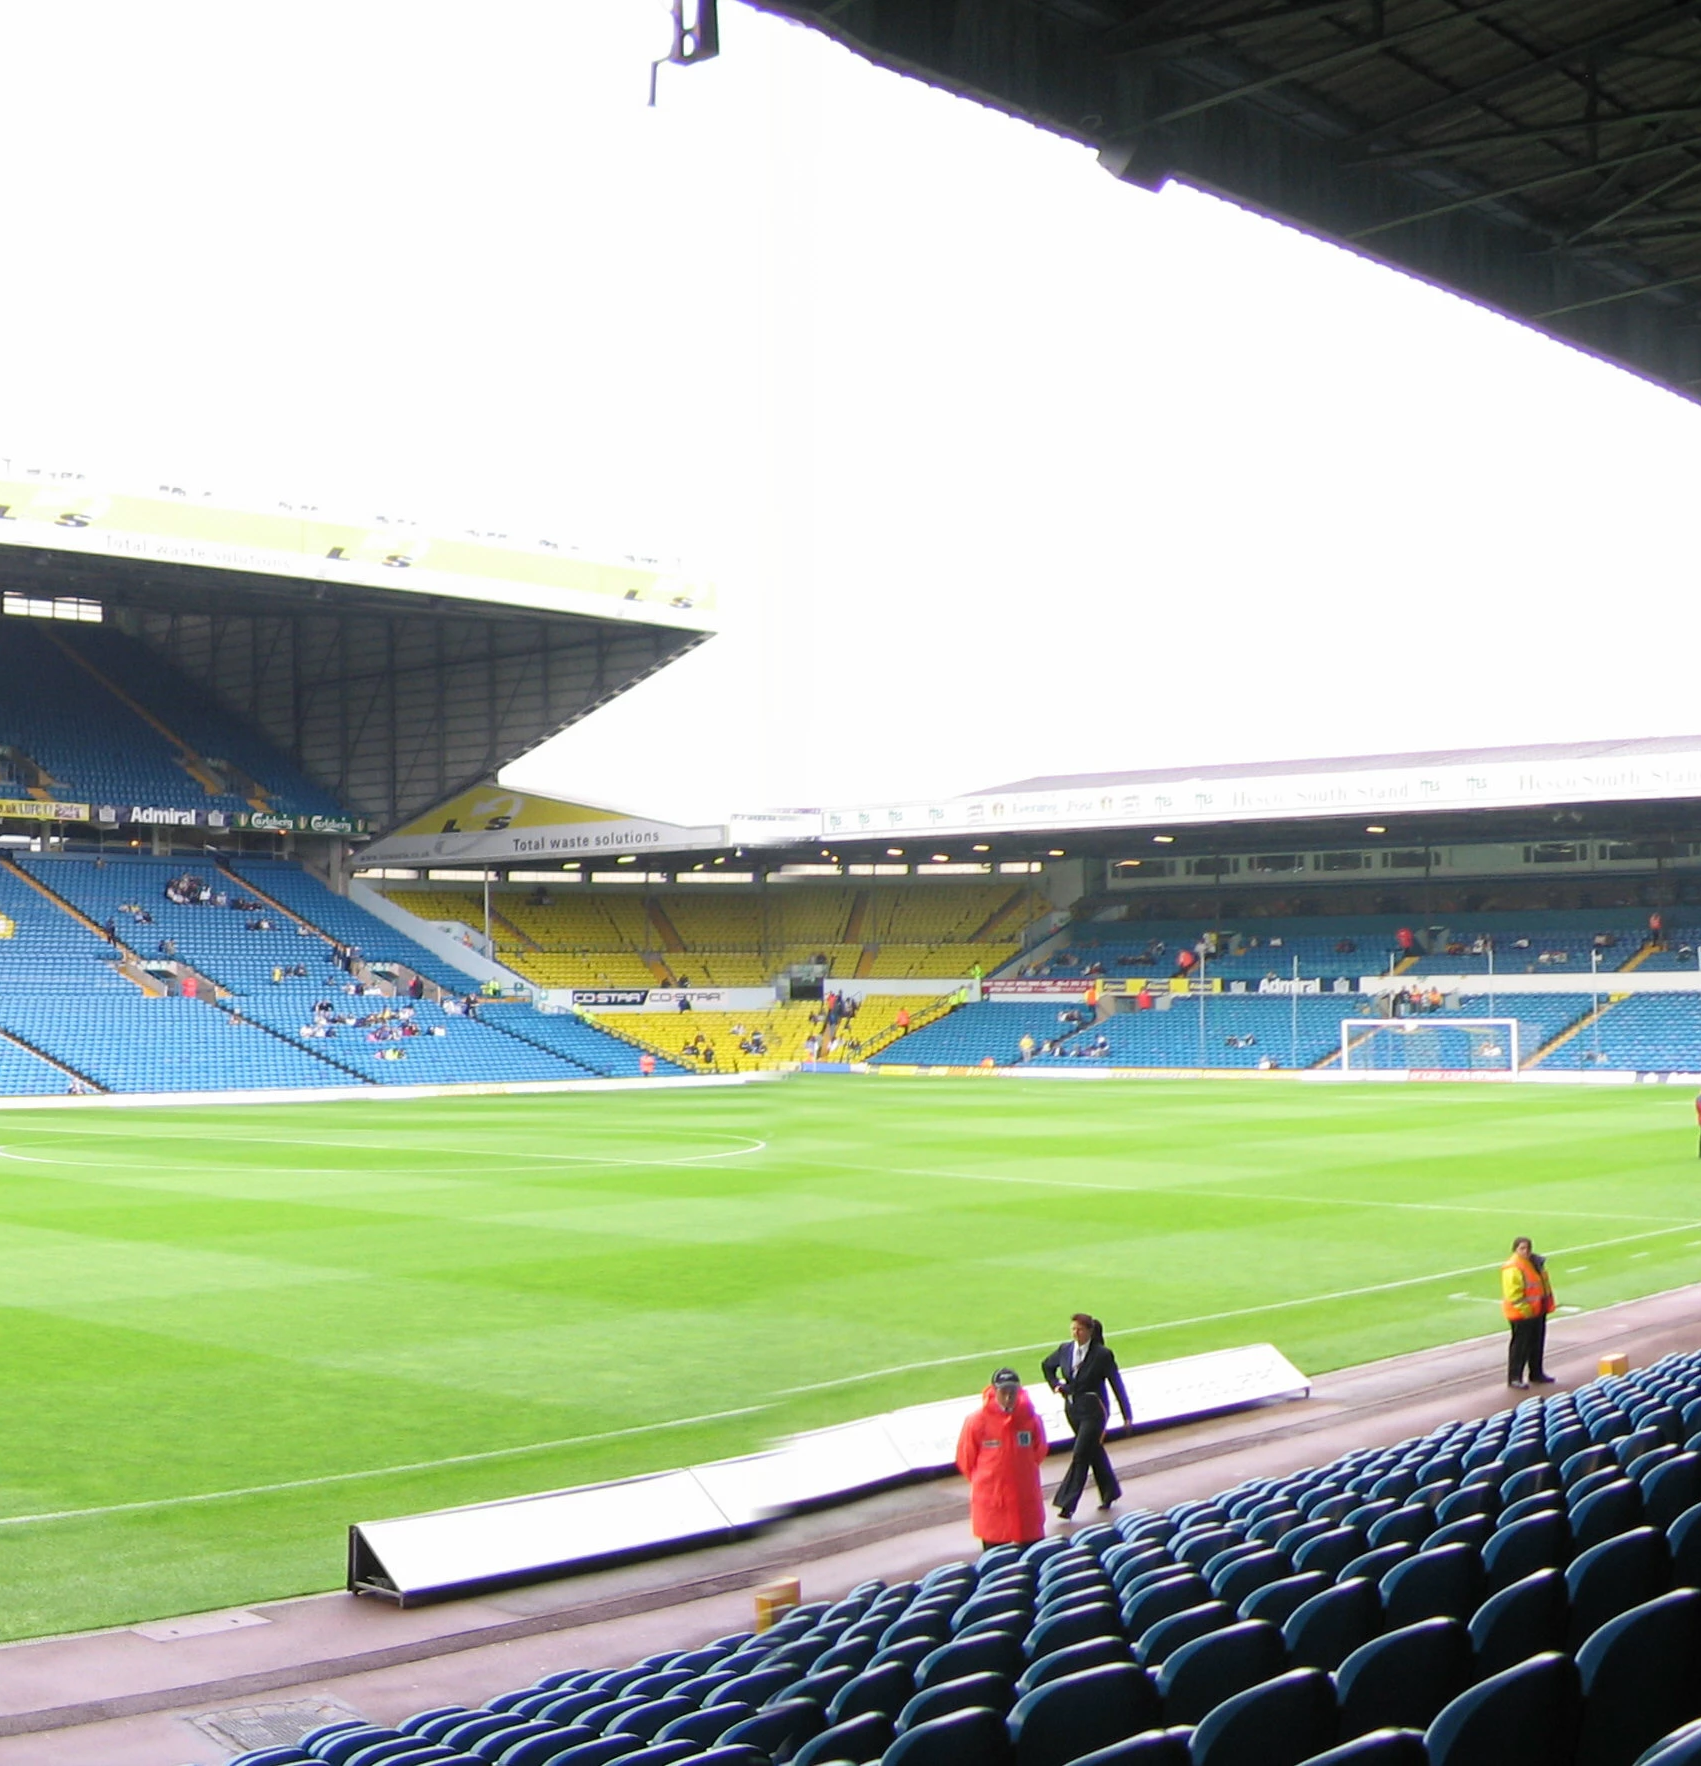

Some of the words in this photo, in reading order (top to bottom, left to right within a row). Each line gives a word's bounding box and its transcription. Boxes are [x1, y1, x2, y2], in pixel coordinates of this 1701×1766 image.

[104, 534, 148, 553] Total
[155, 541, 206, 560] waste
[1296, 788, 1348, 807] South
[1357, 785, 1409, 802] Stand
[130, 806, 197, 824] Admiral
[251, 811, 294, 829] Carlsberg
[310, 815, 352, 832] Carlsberg
[512, 838, 546, 851] Total
[550, 835, 590, 849] waste
[595, 830, 660, 846] solutions
[1258, 978, 1321, 994] Admiral
